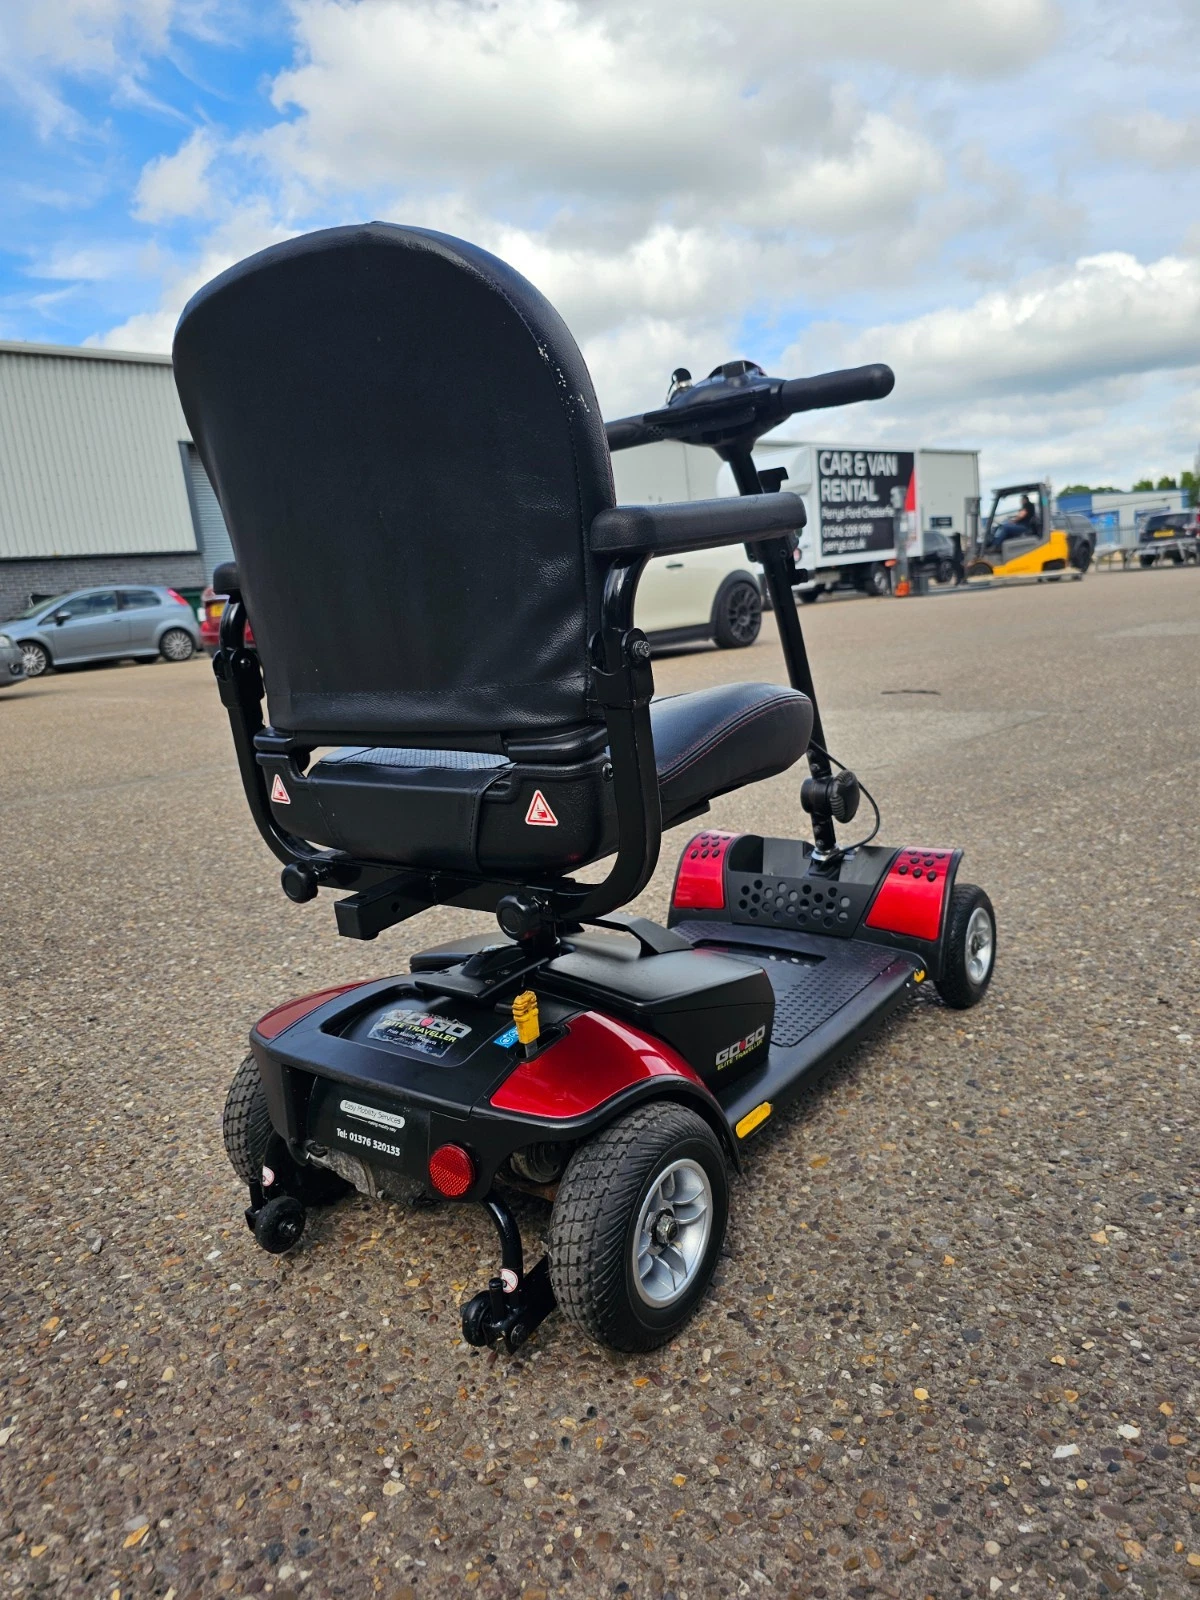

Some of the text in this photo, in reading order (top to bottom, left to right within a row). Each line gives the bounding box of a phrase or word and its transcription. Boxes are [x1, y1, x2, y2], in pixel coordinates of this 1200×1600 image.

[819, 452, 898, 476] CAR & VAN
[820, 478, 880, 502] RENTAL
[408, 1024, 458, 1043] TRAVELLER
[344, 1101, 401, 1125] Easy Mobility Services
[336, 1127, 401, 1157] Tel: 01376 320133
